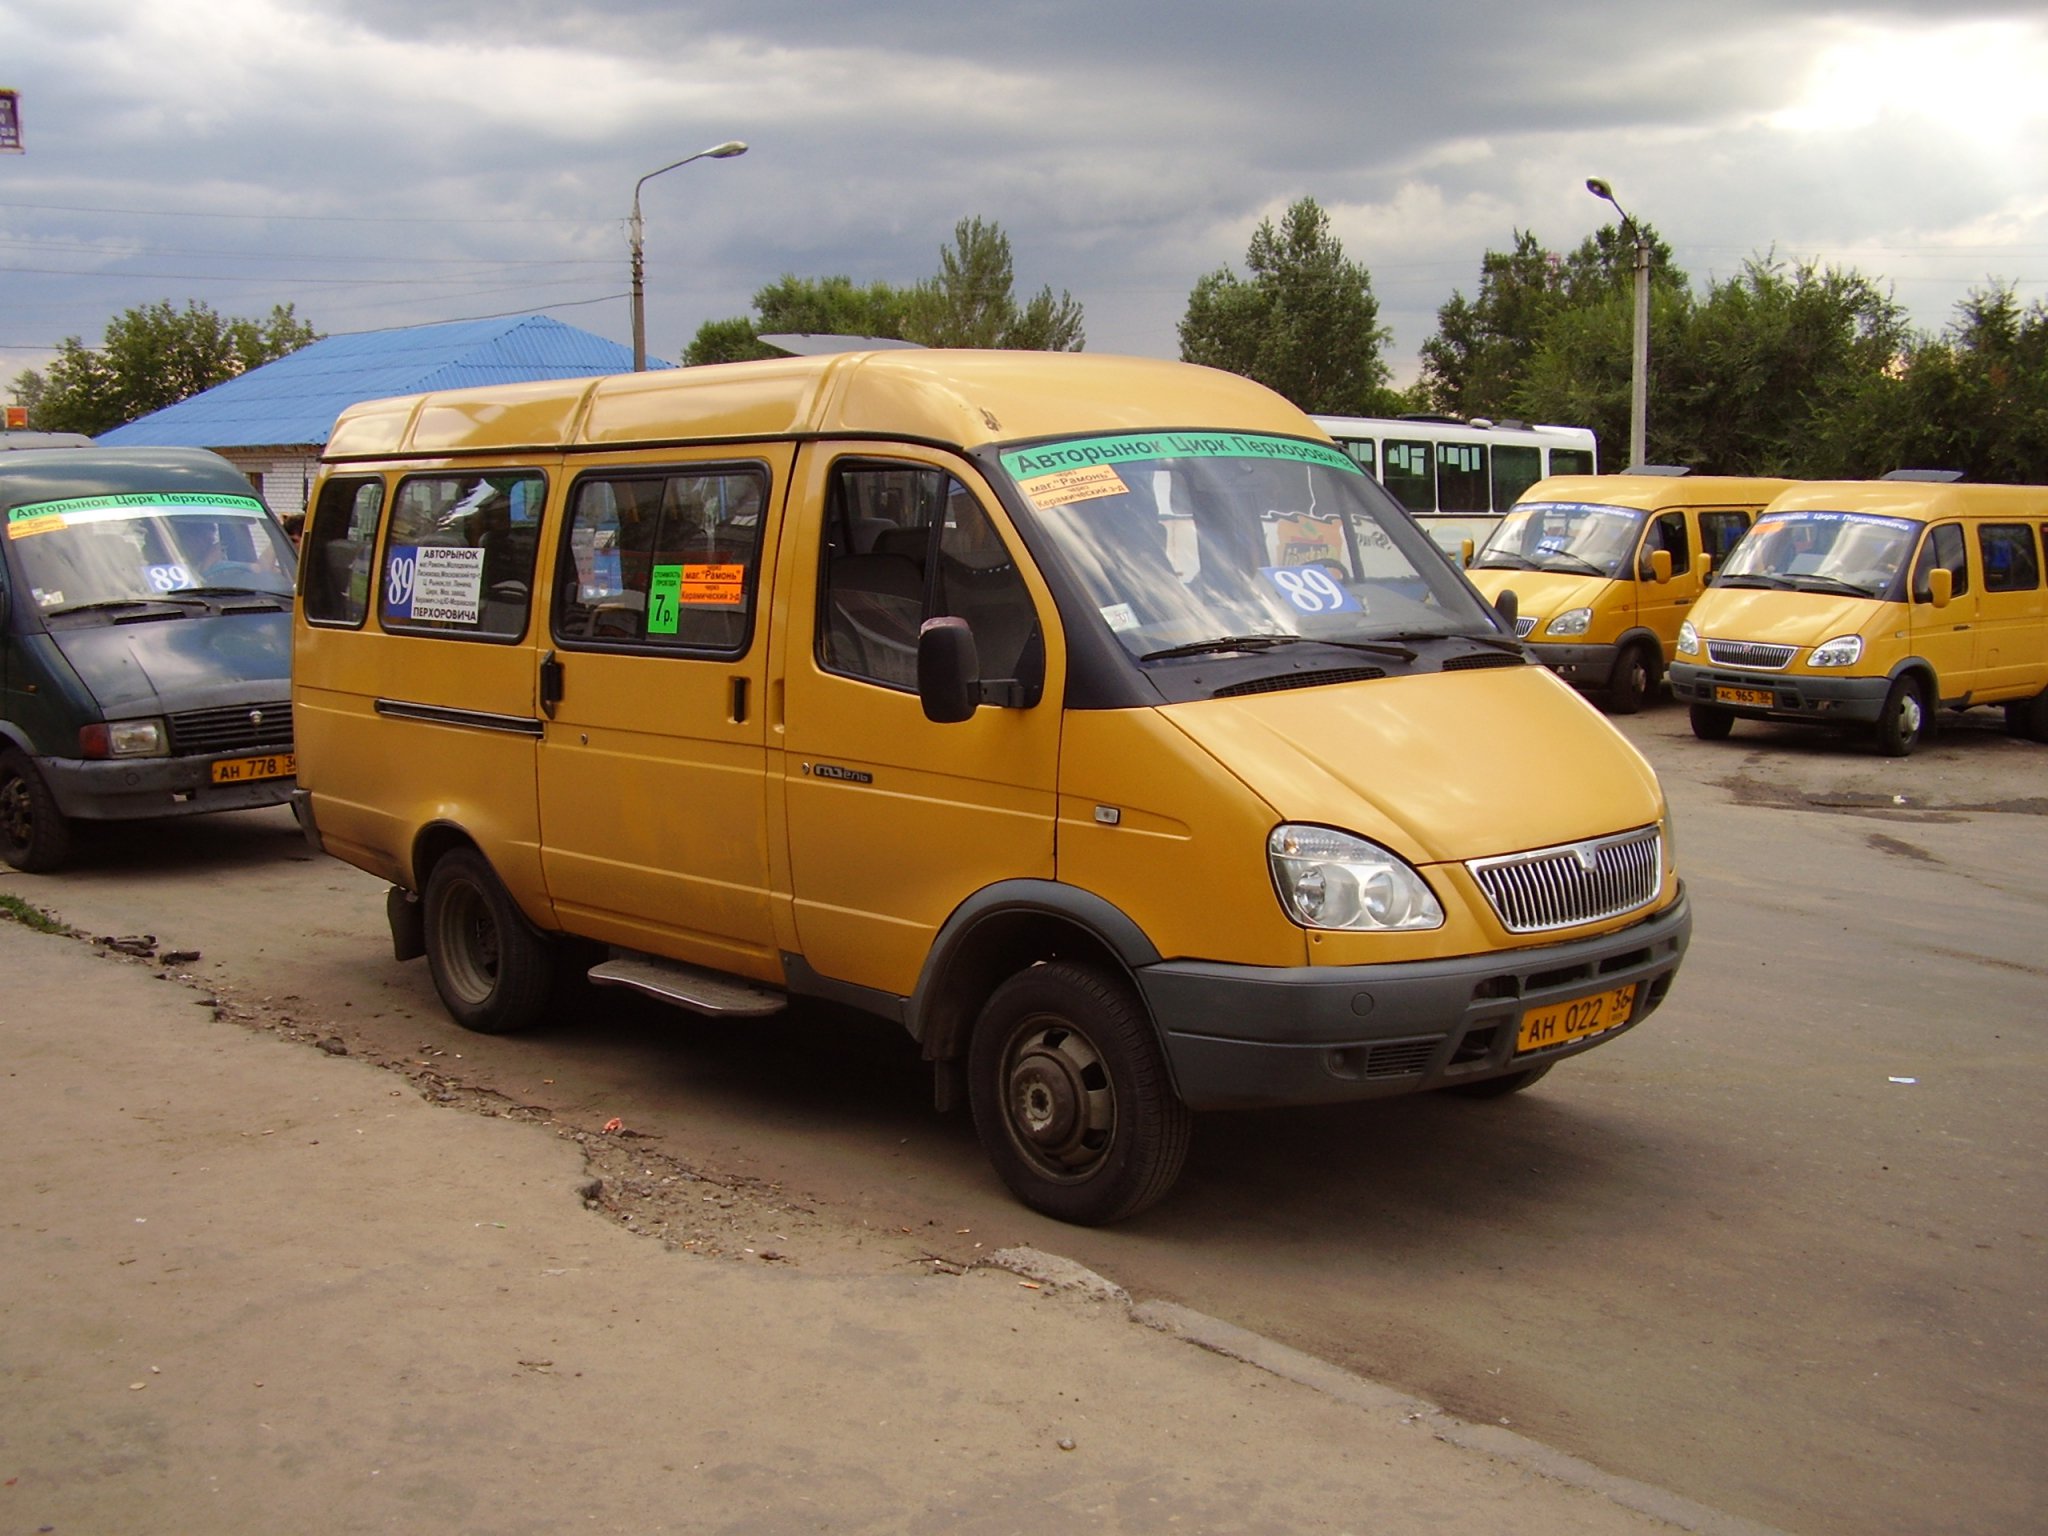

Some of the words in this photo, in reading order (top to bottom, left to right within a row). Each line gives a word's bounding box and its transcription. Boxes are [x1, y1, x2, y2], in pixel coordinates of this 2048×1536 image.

[1016, 440, 1165, 473] Авторынок
[1167, 436, 1231, 455] Цирк
[1231, 436, 1355, 468] Перхоровича
[1055, 470, 1077, 478] через
[16, 498, 110, 519] Авторынок
[115, 494, 154, 506] Цирк
[160, 494, 257, 508] Перхоровича
[1036, 487, 1106, 507] Керамический
[1813, 512, 1839, 521] Цирк
[1842, 514, 1910, 531] Перхоровича
[423, 550, 479, 560] АВТОРЫНОК
[151, 566, 189, 590] 89
[388, 557, 414, 605] 89
[1274, 569, 1343, 611] 89
[413, 607, 476, 621] ПЕРХОРОВИЧА
[655, 594, 666, 622] 7
[1736, 690, 1754, 702] 965
[220, 766, 240, 780] АН
[246, 758, 277, 777] 778
[1528, 1015, 1556, 1042] АН
[1565, 998, 1603, 1033] 022
[1611, 986, 1631, 1012] 36
